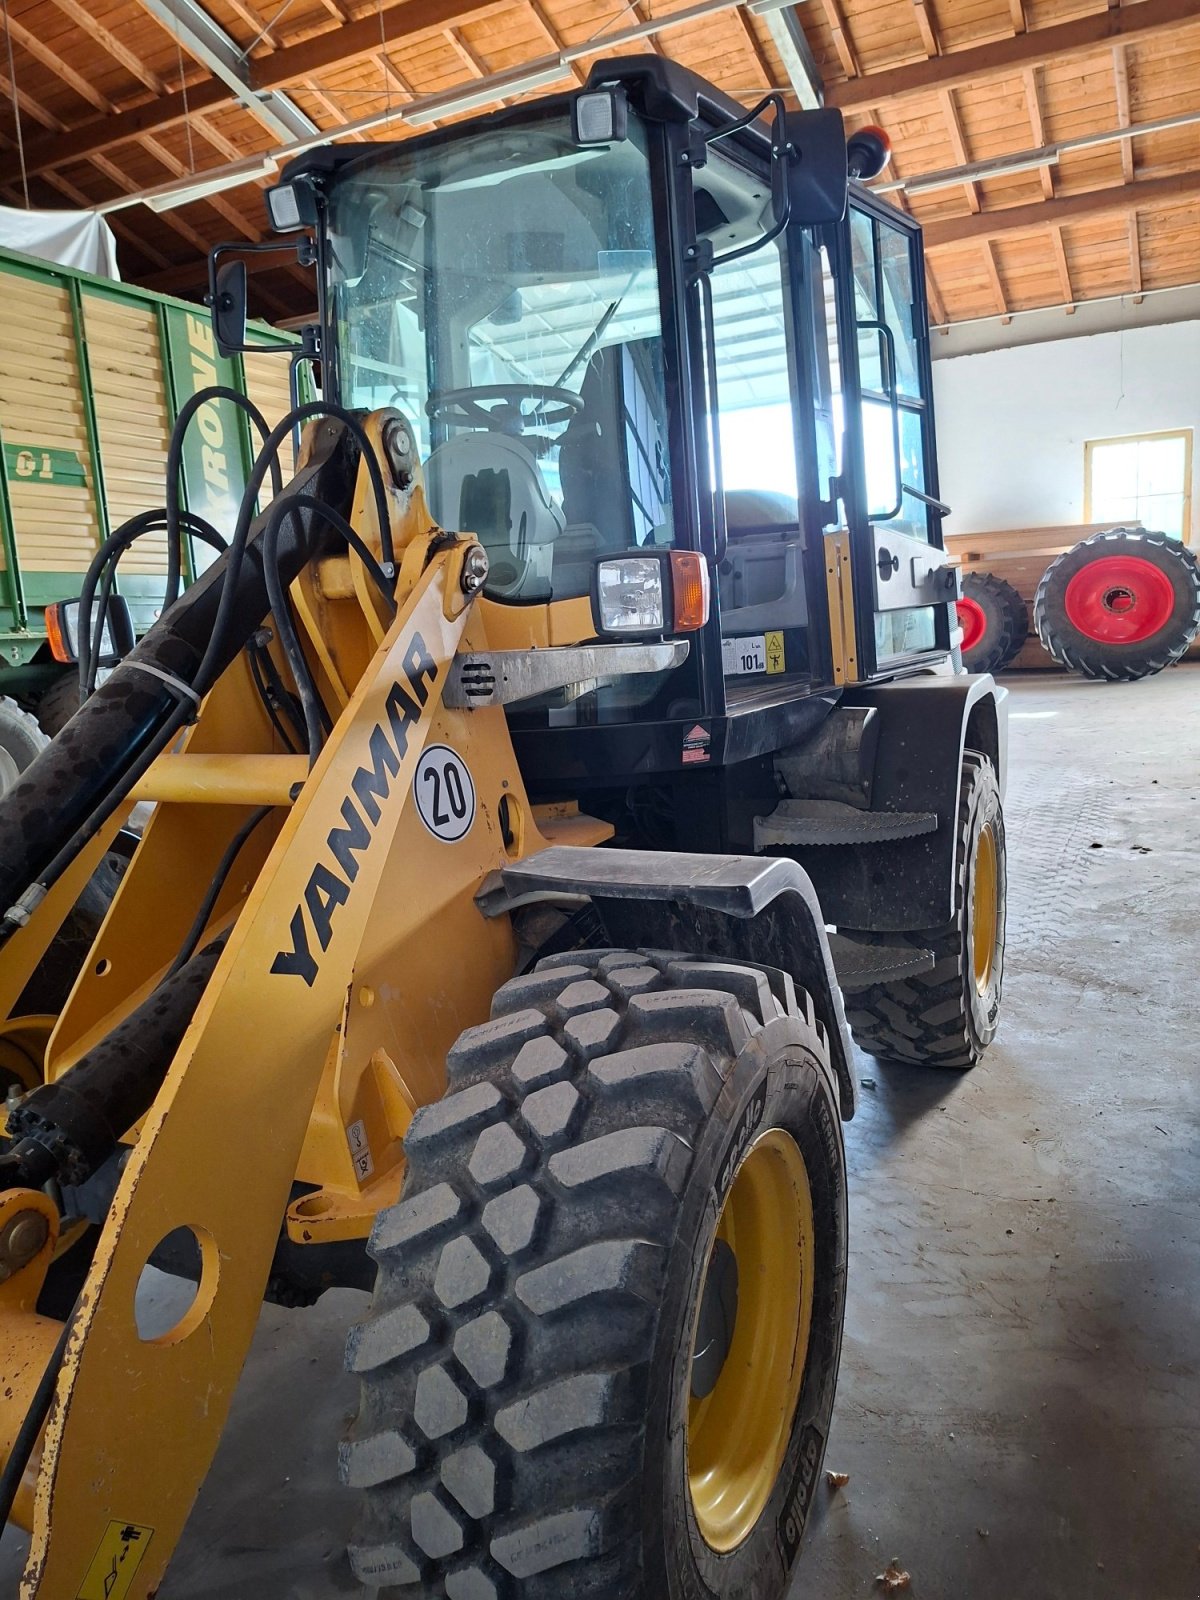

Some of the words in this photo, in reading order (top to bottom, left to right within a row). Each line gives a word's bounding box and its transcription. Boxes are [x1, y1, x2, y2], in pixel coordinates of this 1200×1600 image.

[186, 313, 237, 530] KRONE
[740, 654, 758, 670] 101
[270, 631, 439, 988] YANMAR
[423, 762, 466, 827] 20
